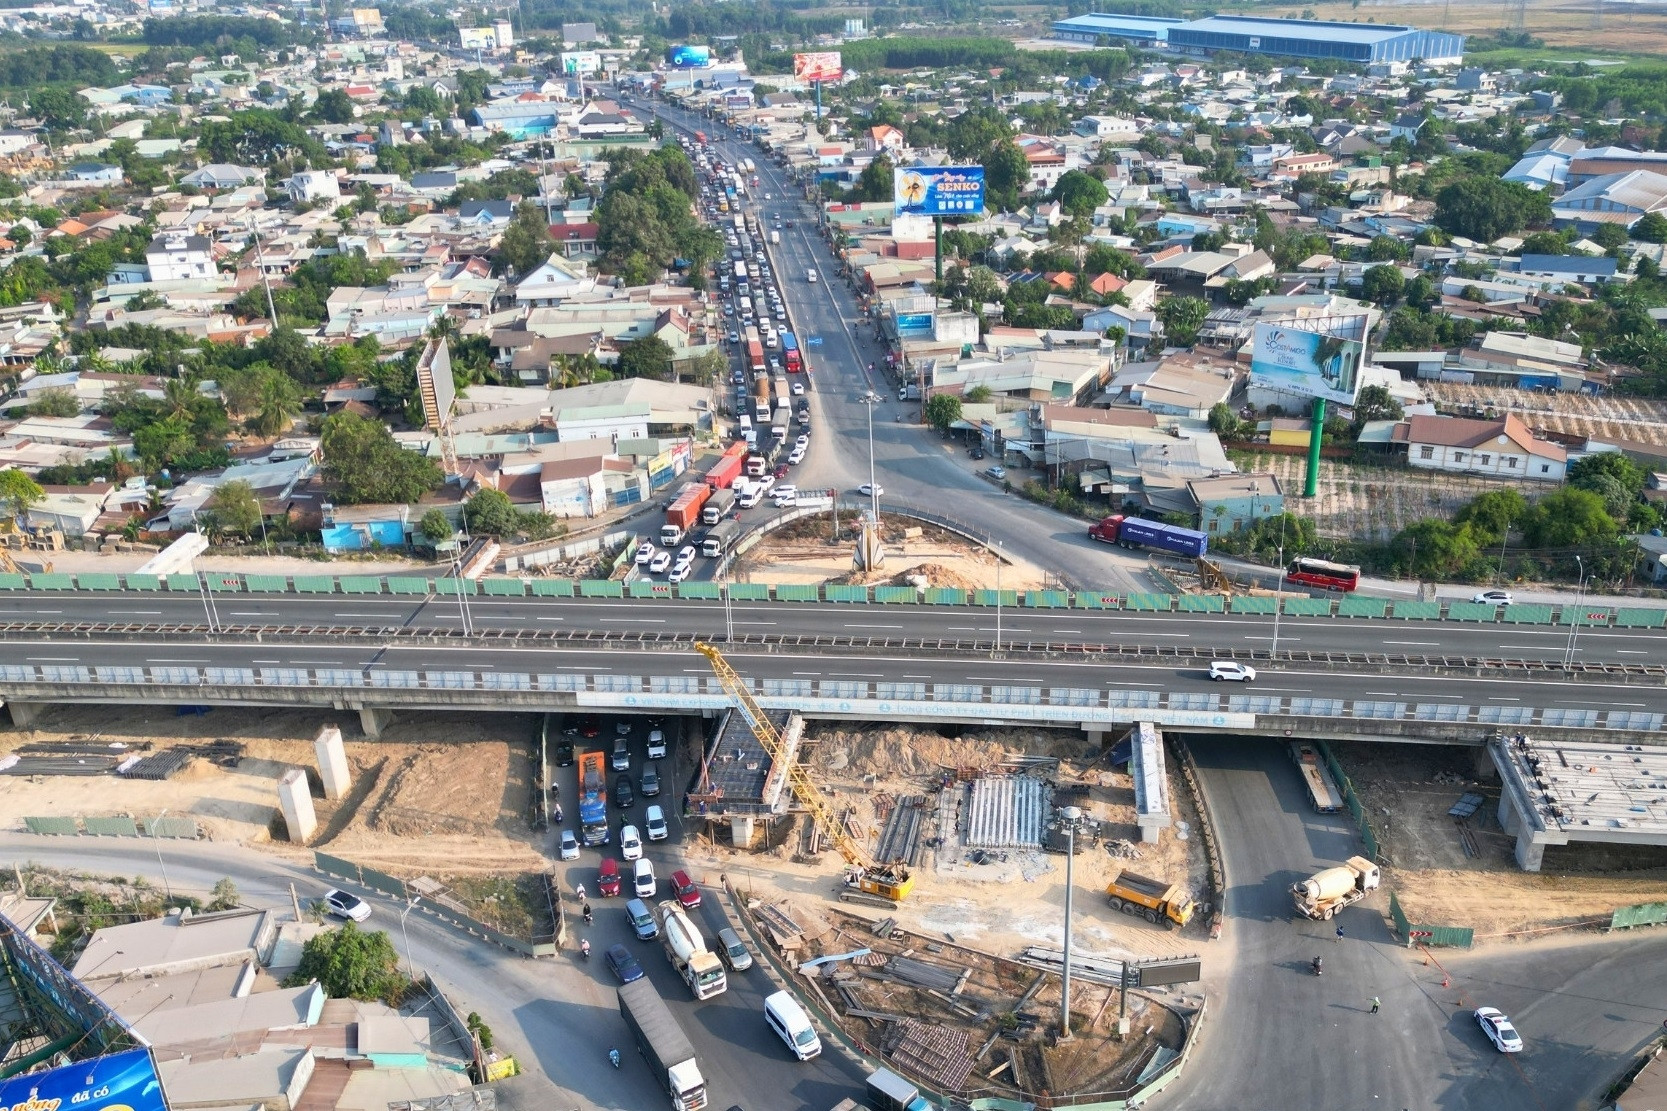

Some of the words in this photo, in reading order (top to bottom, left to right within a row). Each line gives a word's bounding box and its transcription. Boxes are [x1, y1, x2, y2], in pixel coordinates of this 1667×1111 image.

[937, 182, 980, 191] SENKO
[1186, 715, 1208, 724] NAM
[71, 1091, 90, 1104] đã
[93, 1085, 110, 1099] có
